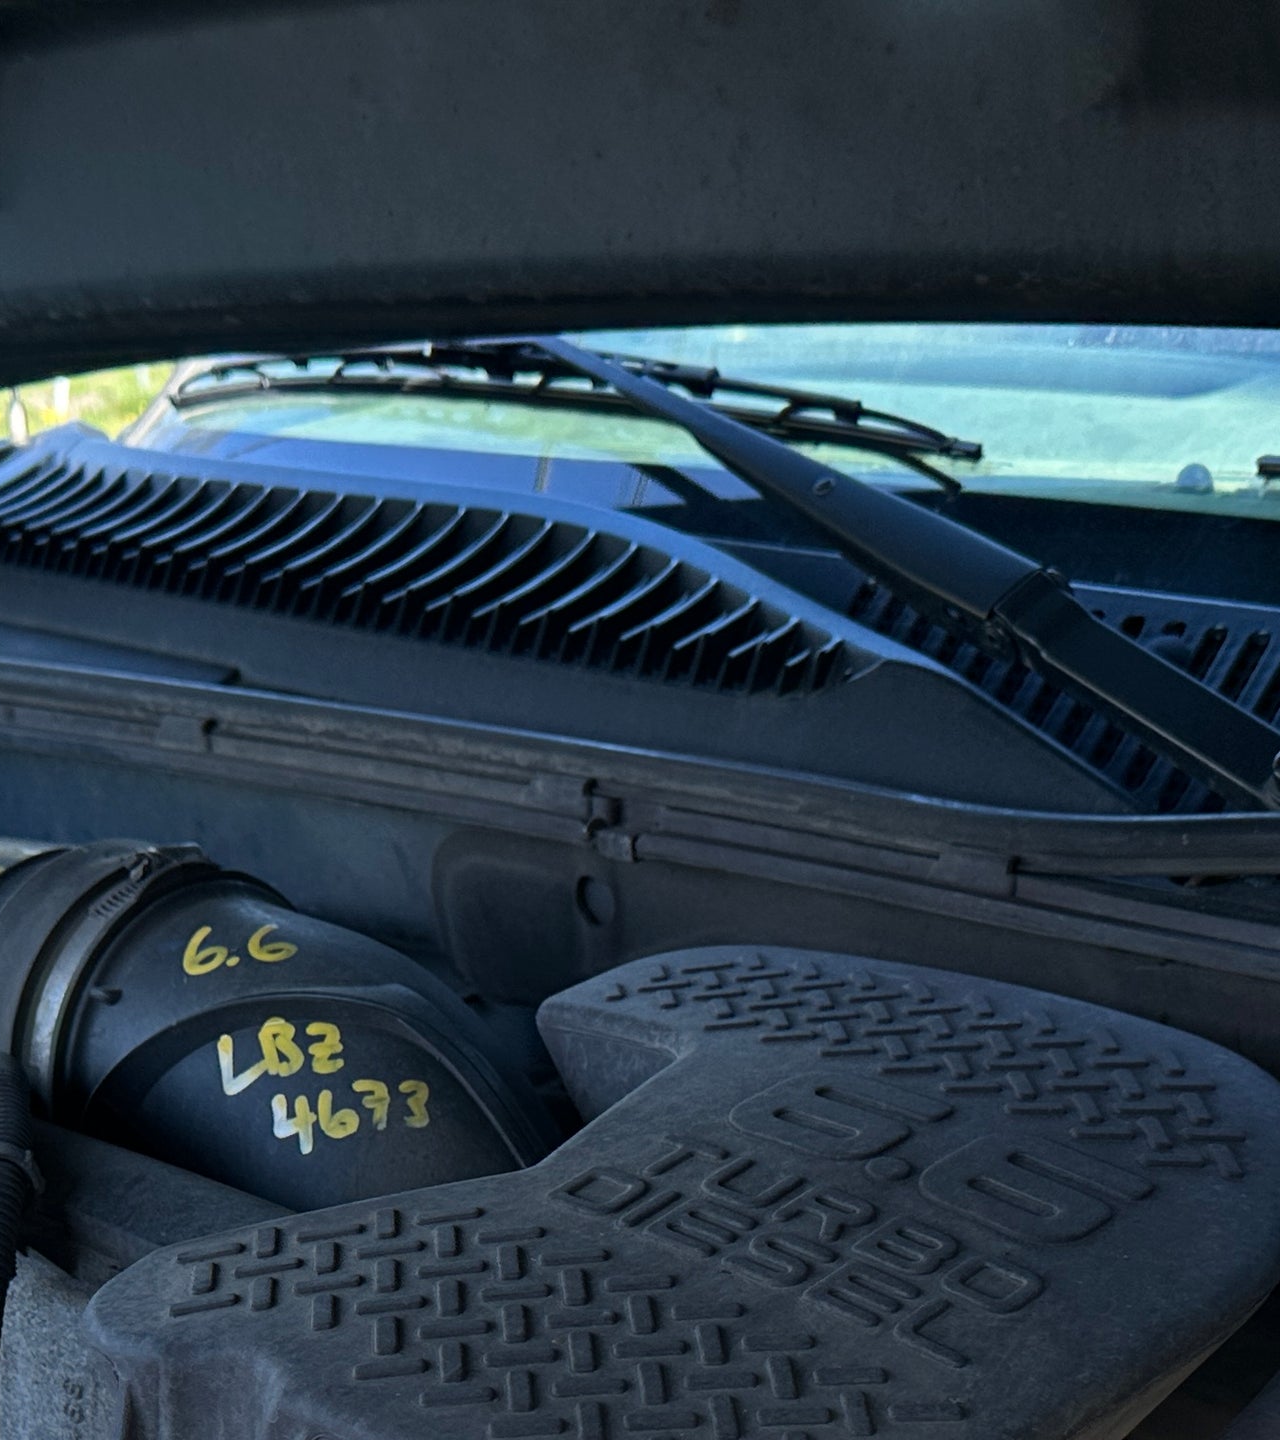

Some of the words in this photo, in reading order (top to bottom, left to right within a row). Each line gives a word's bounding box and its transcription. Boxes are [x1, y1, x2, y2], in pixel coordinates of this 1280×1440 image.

[182, 923, 299, 976] 6.6
[271, 1078, 430, 1155] 4673
[547, 1165, 972, 1368] DIESEL
[642, 1133, 1046, 1314] TURBO
